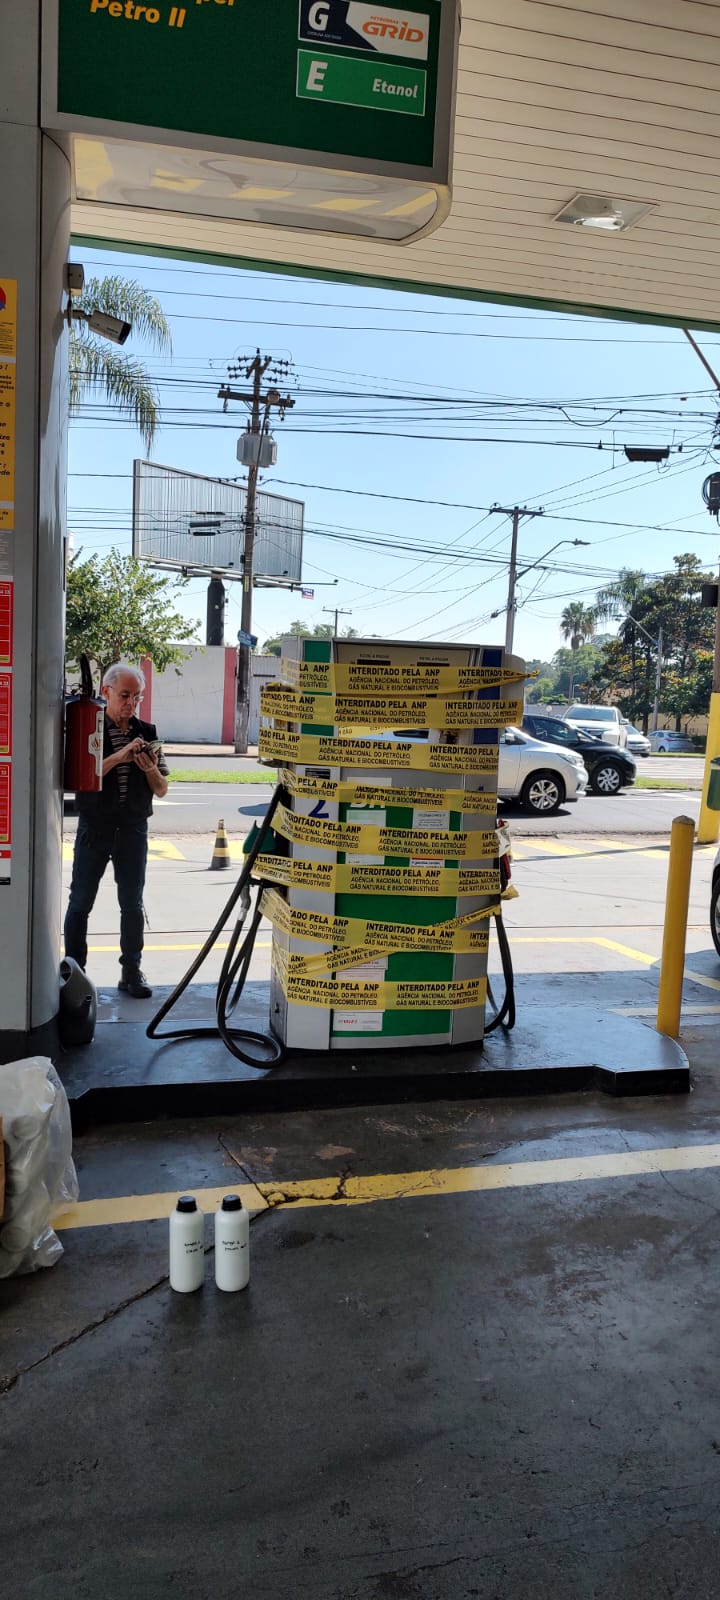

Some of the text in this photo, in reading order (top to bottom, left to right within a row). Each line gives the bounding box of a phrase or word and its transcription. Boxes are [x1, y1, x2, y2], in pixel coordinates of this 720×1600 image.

[90, 0, 160, 23] Petro
[308, 1, 330, 31] G
[306, 60, 329, 92] E
[372, 78, 418, 98] Etanol
[313, 665, 331, 673] ANP
[348, 667, 441, 678] INTERDITADO PELA ANP
[349, 676, 373, 684] AGÊNCIA
[299, 696, 315, 705] ANP
[335, 698, 428, 710] INTERDITADO PELA ANP
[445, 701, 491, 711] INTERDITADO
[335, 707, 358, 715] AGÊNCIA
[361, 709, 387, 717] NACIONAL
[347, 715, 371, 723] NATURAL
[272, 731, 300, 743] PELA ANP
[319, 737, 413, 752] INTERDITADO PELA ANP
[319, 746, 343, 755] AGÊNCIA
[430, 745, 494, 756] INTERDITADO PELA
[297, 777, 339, 791] PELA ANP
[366, 794, 391, 802] NATURAL
[322, 821, 361, 833] PELA ANP
[379, 829, 467, 841] INTERDITADO PELA ANP
[391, 845, 414, 854] NATURAL
[403, 840, 429, 848] NACIONAL
[293, 860, 334, 873] PELA ANP
[351, 866, 441, 878] INTERDITADO PELA ANP
[351, 875, 374, 883] AGÊNCIA
[309, 914, 349, 928] PELA ANP
[366, 922, 455, 939] INTERDITADO PELA ANP
[366, 931, 388, 940] AGÊNCIA
[390, 935, 415, 943] NACIONAL
[376, 940, 400, 948] NATURAL
[339, 955, 363, 967] NATURAL
[288, 976, 380, 991] INTERDITADO PELA ANP
[396, 980, 480, 991] INTERDITADO PELA ANP
[312, 989, 338, 998] NACIONAL
[397, 991, 419, 999] AGÊNCIA
[299, 995, 322, 1004] NATURAL
